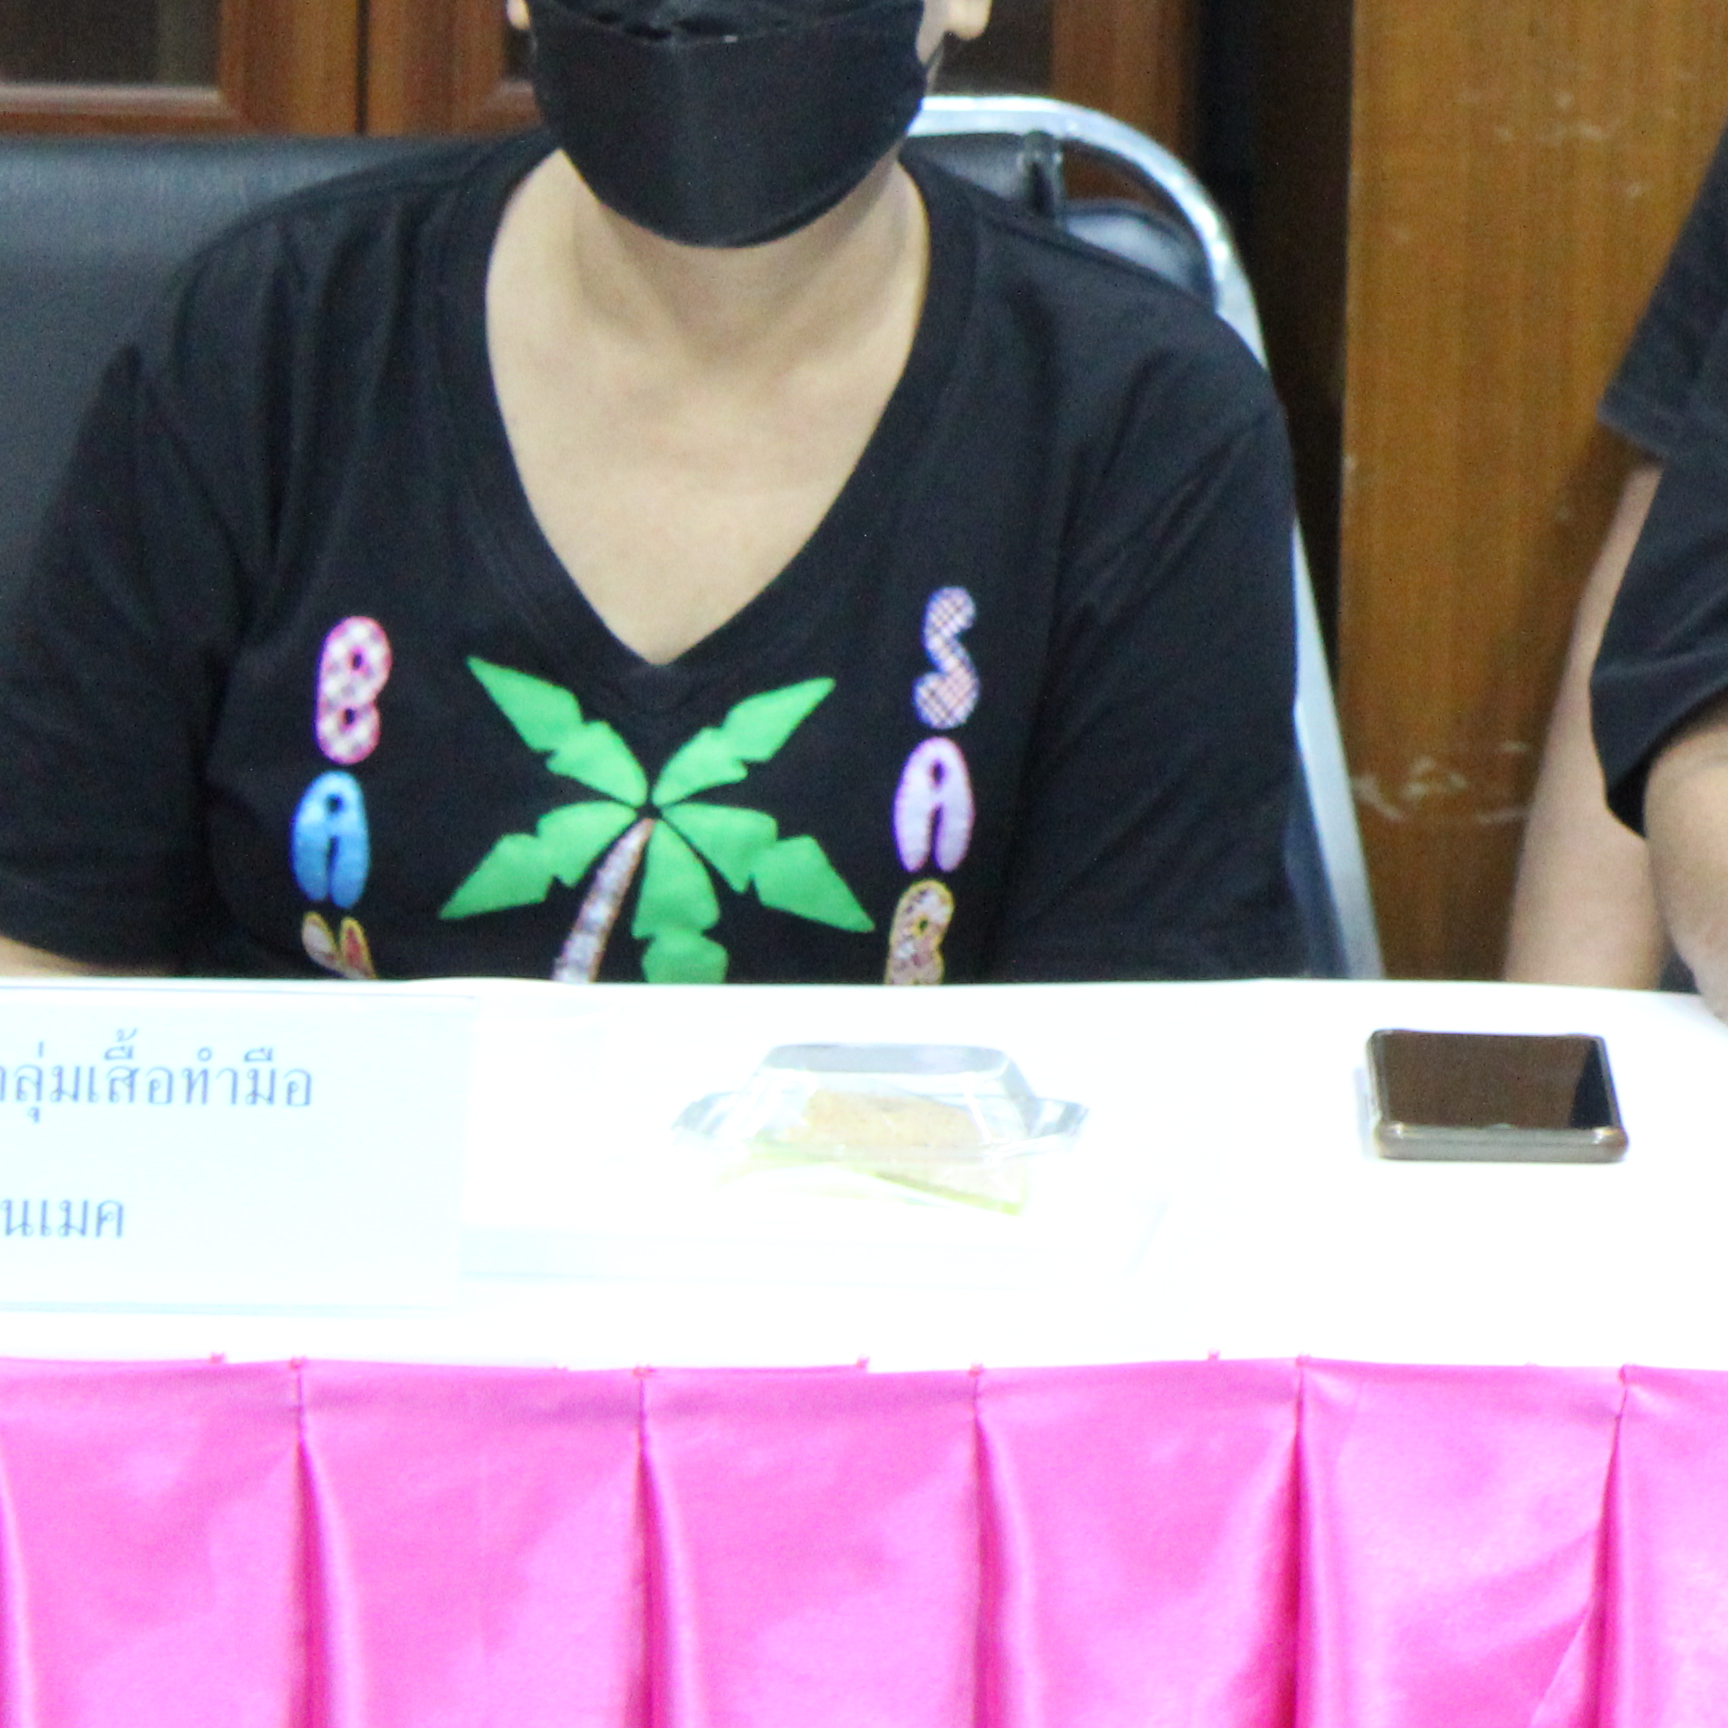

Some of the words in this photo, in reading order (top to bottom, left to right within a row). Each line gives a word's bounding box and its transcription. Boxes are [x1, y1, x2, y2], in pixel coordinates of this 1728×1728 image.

[0, 1027, 313, 1124] ลุ่มเสื้อทำมือ
